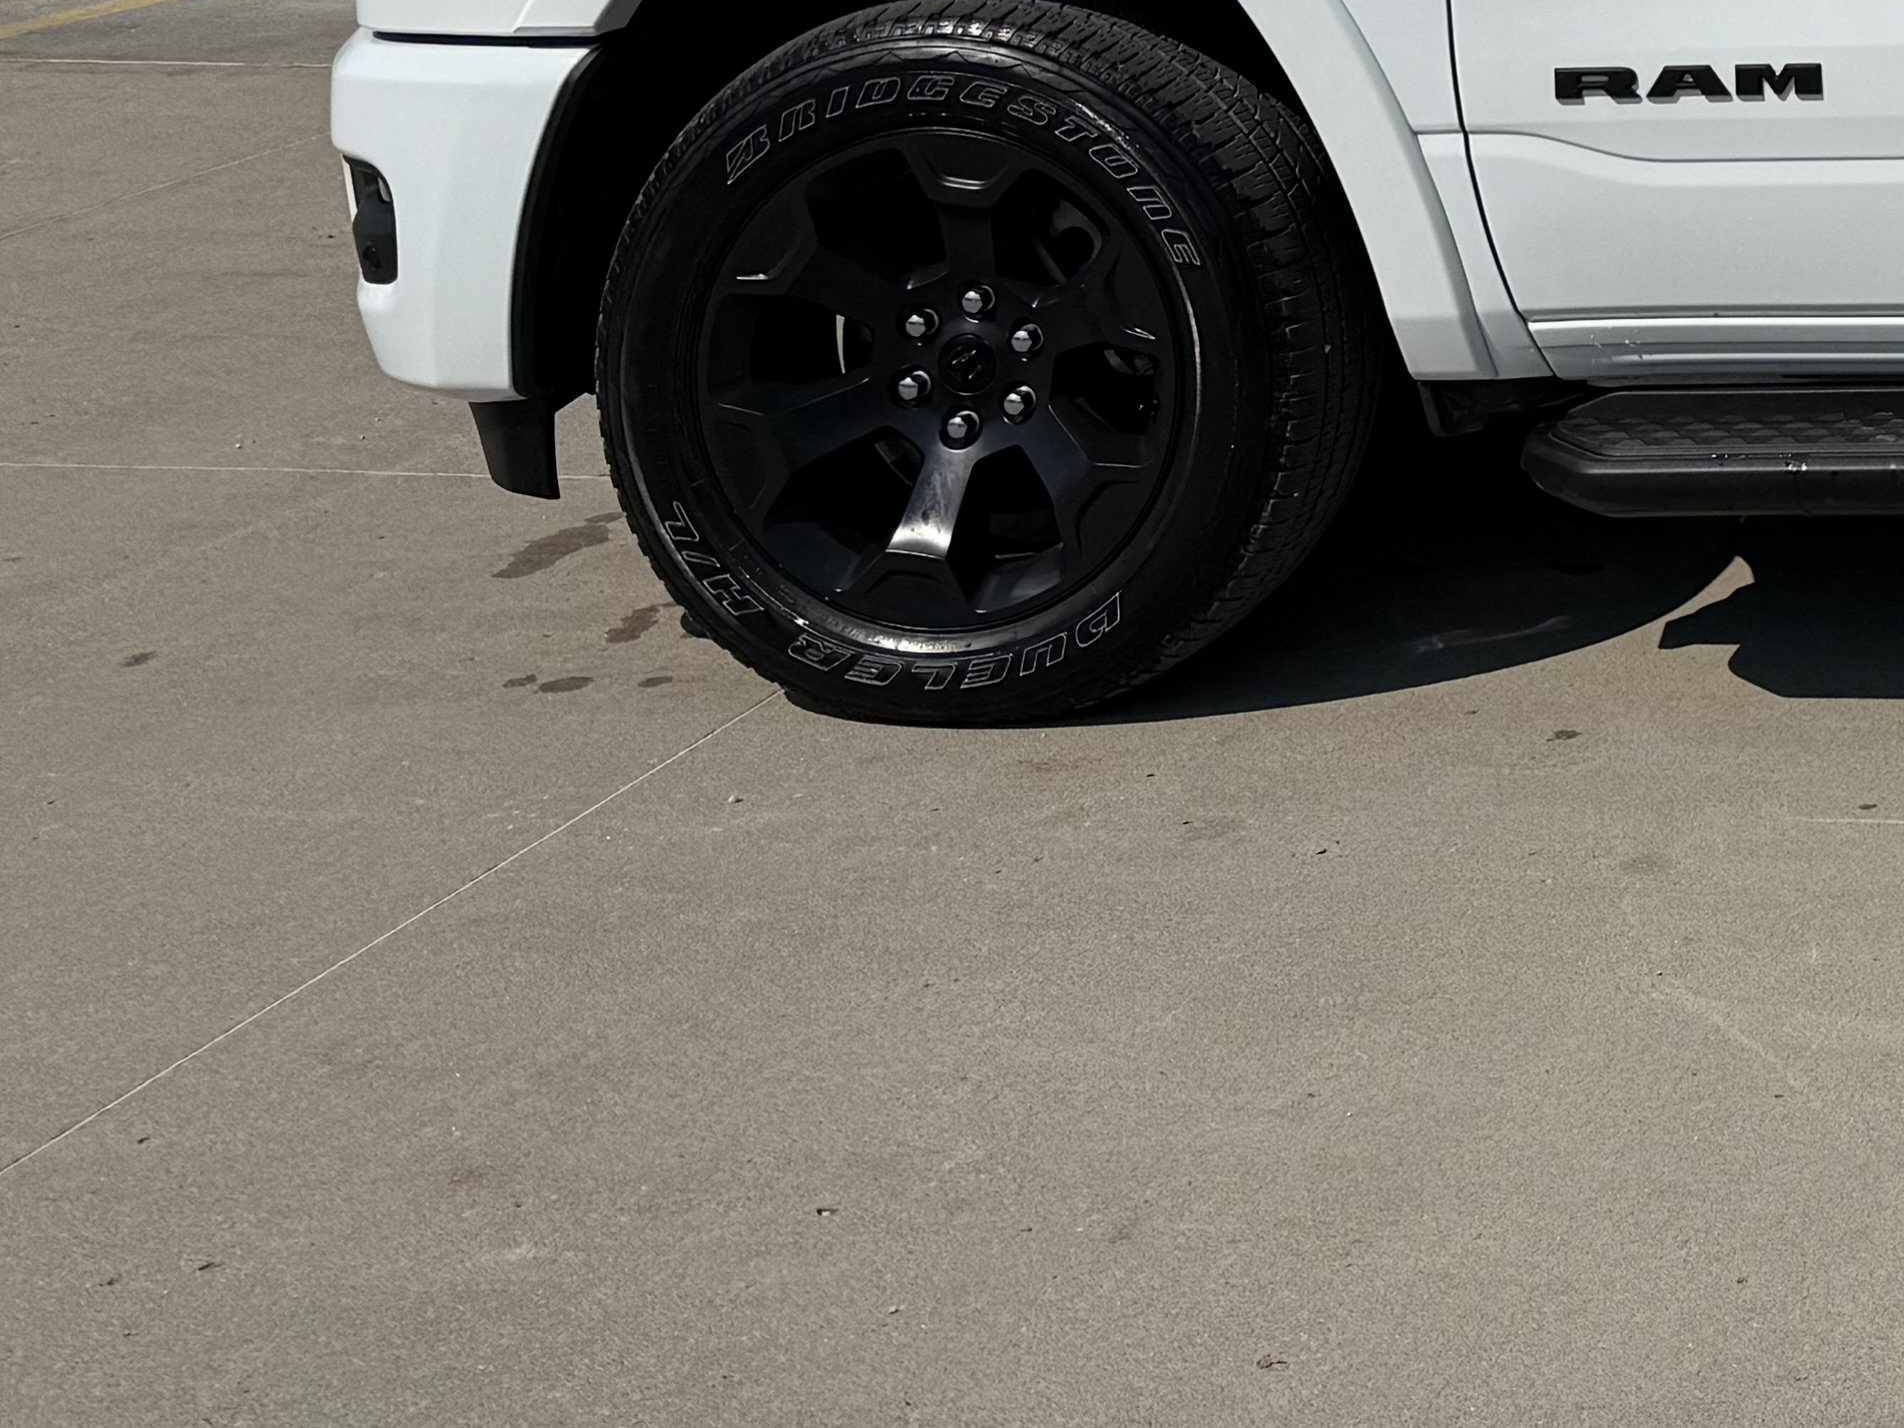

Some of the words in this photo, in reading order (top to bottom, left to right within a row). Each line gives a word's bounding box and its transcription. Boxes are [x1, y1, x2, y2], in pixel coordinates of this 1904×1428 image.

[1554, 63, 1824, 105] RAM
[725, 75, 1200, 265] BRIDGESTONE
[788, 590, 1122, 690] DUELER
